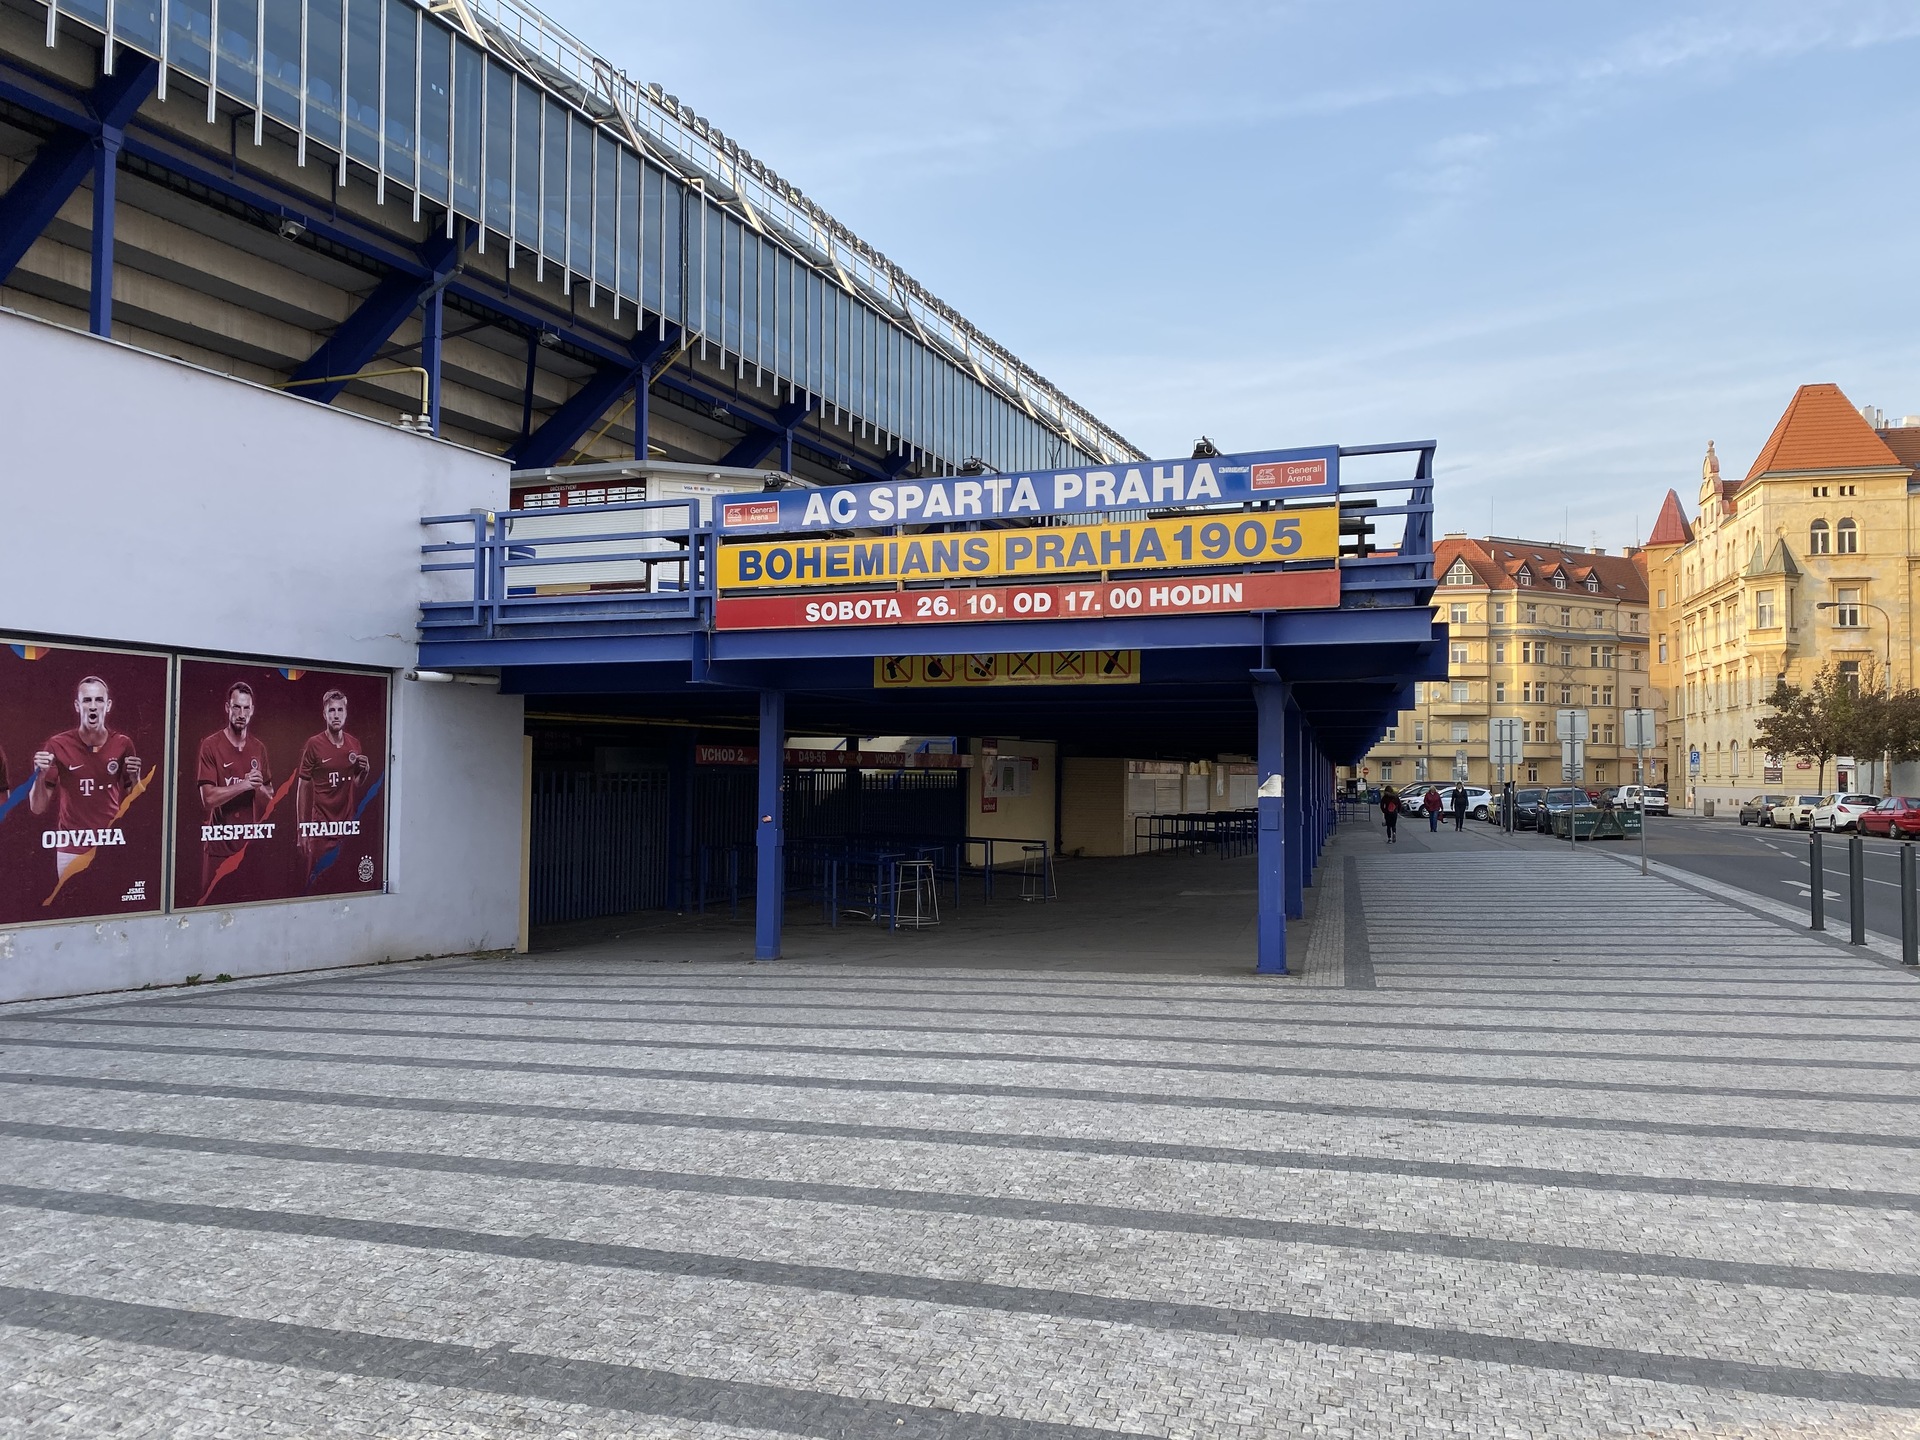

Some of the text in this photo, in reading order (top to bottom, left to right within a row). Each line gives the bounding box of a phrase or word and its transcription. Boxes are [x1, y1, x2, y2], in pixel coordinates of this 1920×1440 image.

[1287, 464, 1322, 475] Generali
[1287, 474, 1312, 483] Arena
[801, 463, 1222, 526] AC SPARTA PRAHA
[749, 505, 776, 514] Generali
[749, 513, 769, 521] Arena
[738, 517, 1303, 582] BOHEMIANS PRAHA 1905
[805, 582, 1243, 623] SOBOTA 26. 10. OD 17. 00 HODIN
[701, 747, 735, 762] VCHOD
[737, 748, 744, 761] 2
[798, 751, 827, 763] D49-56
[875, 753, 897, 765] VCHOD
[201, 823, 276, 842] RESPEKT
[299, 820, 360, 838] TRADICE
[42, 828, 126, 849] ODVAHA
